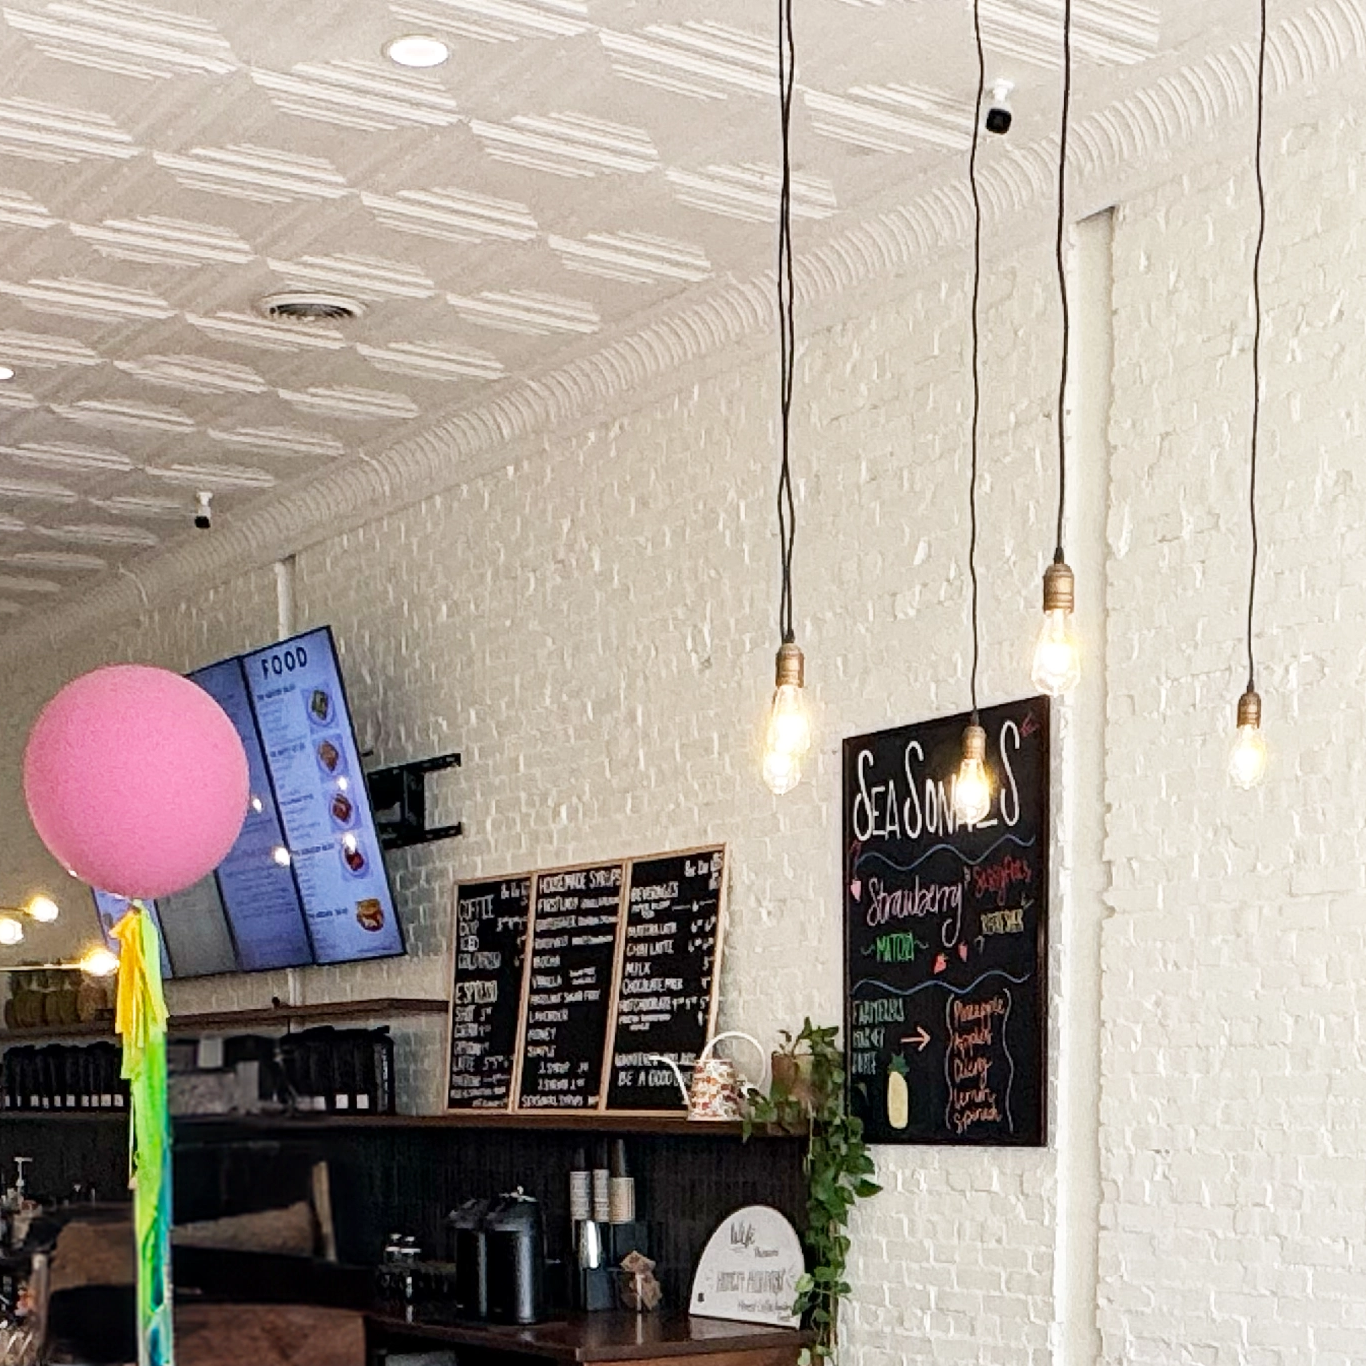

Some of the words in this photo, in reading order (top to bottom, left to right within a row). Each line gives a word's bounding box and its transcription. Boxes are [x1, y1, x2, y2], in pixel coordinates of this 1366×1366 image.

[261, 646, 308, 680] FOOD
[866, 873, 963, 948] Strawberry
[624, 961, 653, 976] MILK
[617, 1070, 635, 1088] BE
[637, 1070, 647, 1088] A
